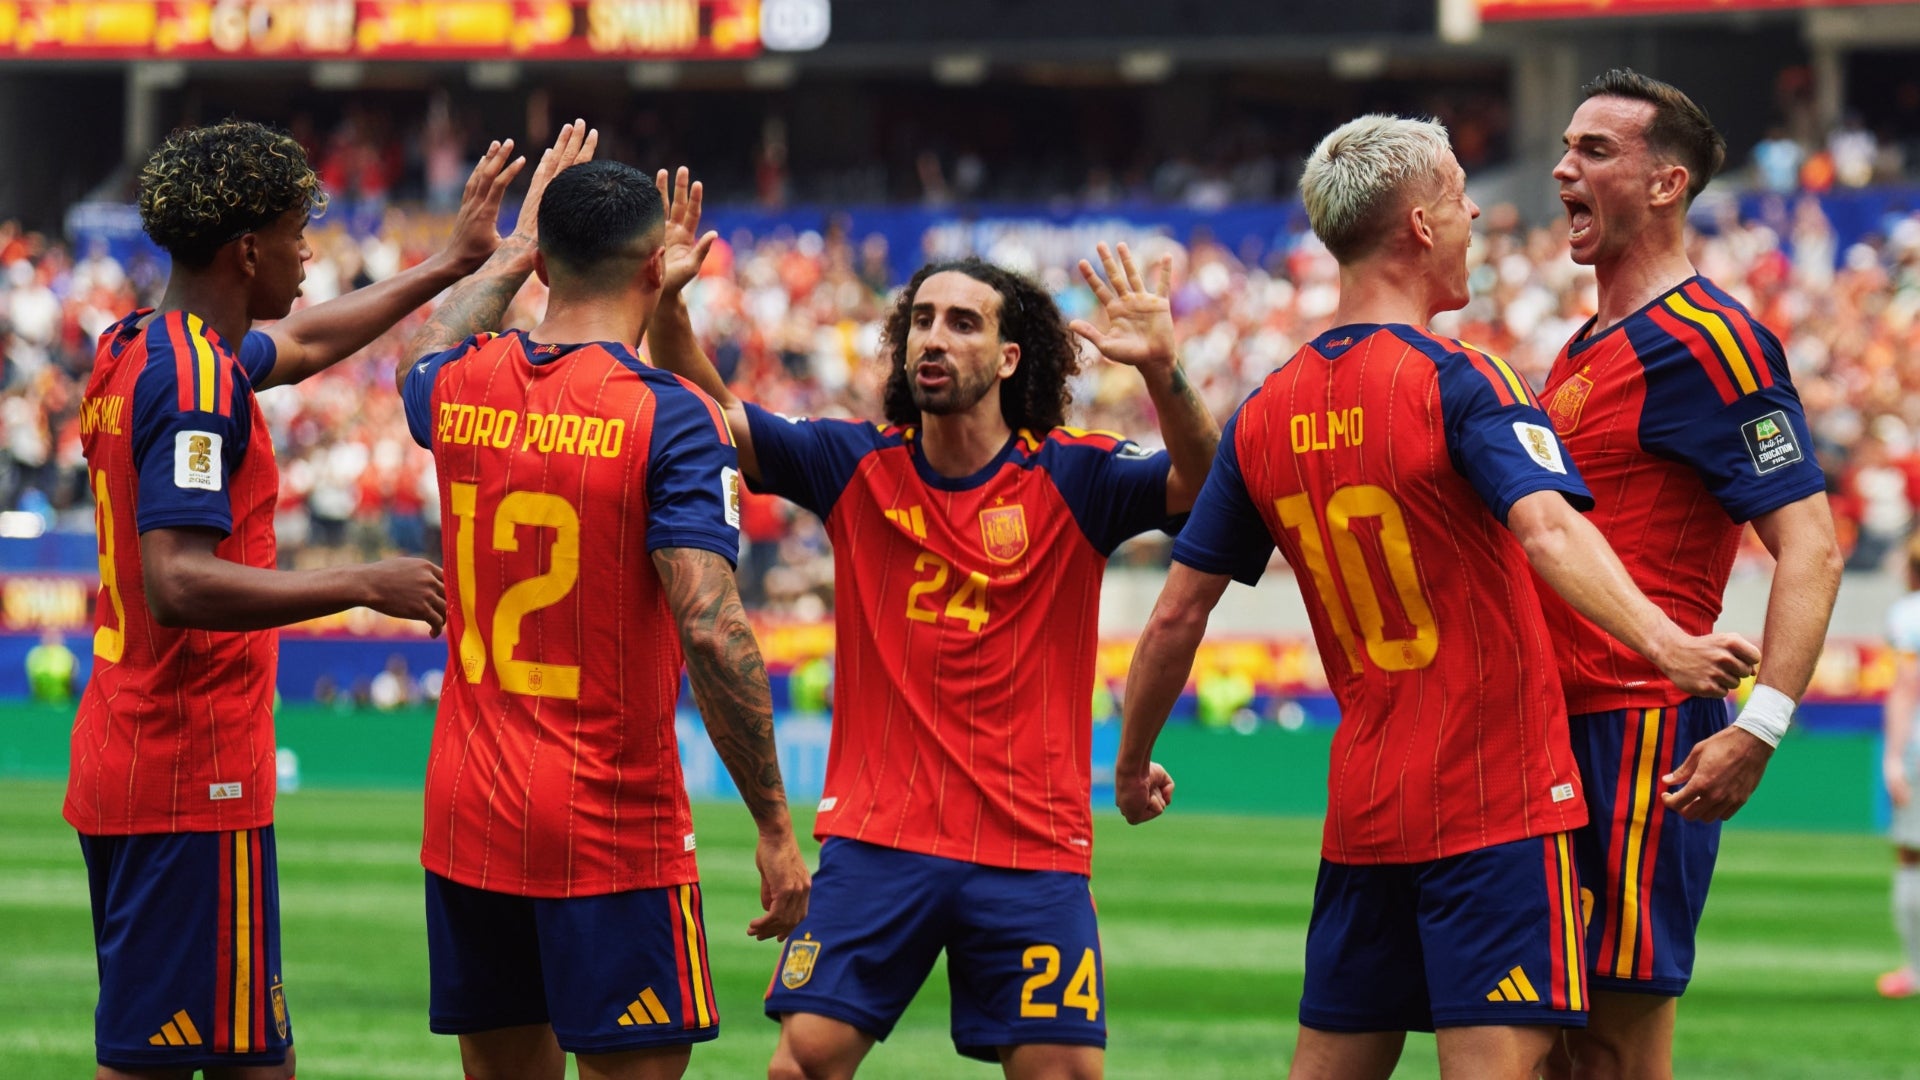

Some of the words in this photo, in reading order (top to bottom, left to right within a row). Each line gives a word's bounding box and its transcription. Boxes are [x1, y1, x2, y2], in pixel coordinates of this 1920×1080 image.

[437, 401, 518, 449] PEDRO
[521, 413, 625, 458] PORRO
[1290, 406, 1363, 453] OLMO
[1759, 443, 1793, 462] EDUCATION
[87, 465, 125, 664] 9
[451, 482, 581, 700] 12
[906, 551, 990, 633] 24
[1274, 484, 1439, 676] 10
[1021, 945, 1099, 1022] 24
